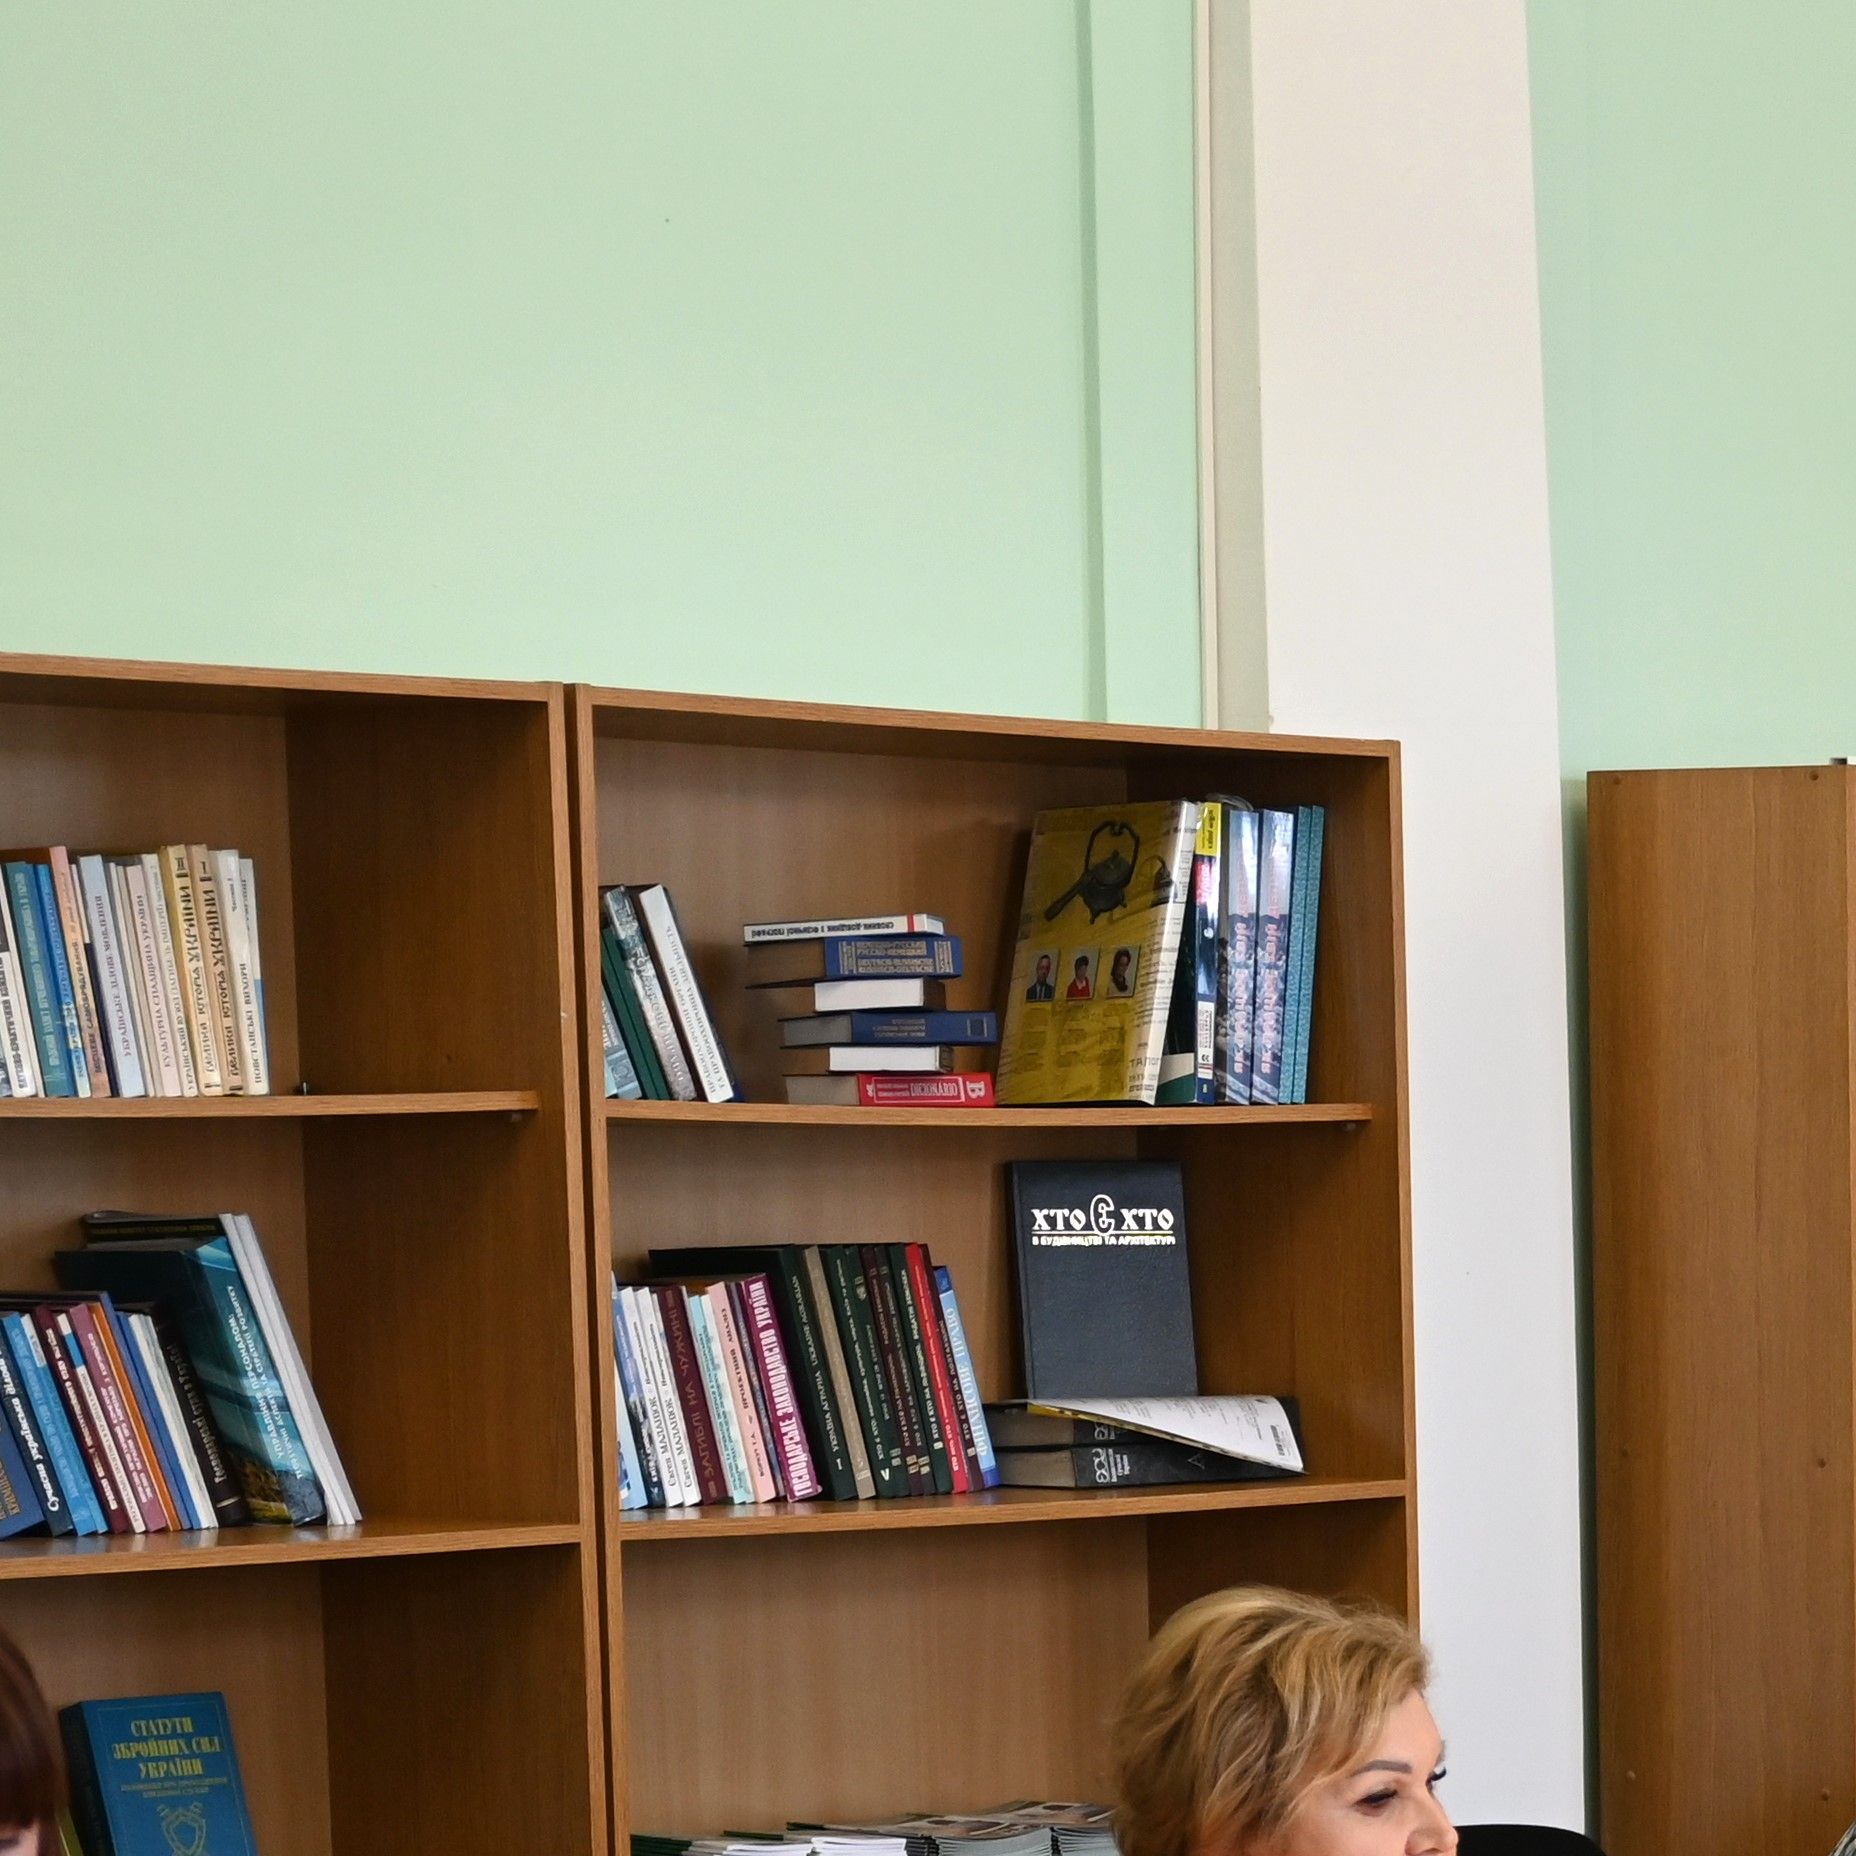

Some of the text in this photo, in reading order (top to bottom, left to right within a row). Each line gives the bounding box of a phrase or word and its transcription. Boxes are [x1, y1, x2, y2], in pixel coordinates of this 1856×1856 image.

[135, 894, 150, 940] УКРАЇНИ
[154, 1008, 171, 1068] КУЛЬТУРНА
[1031, 1194, 1174, 1236] ХТО Є ХТО
[1105, 1236, 1117, 1245] ТА
[747, 1279, 772, 1328] УКРАЇНИ
[667, 1308, 714, 1476] ЗАГИБЛІ НА ЧУЖИНІ
[758, 1327, 794, 1416] ЗАКОНОДАВСТВО
[944, 1306, 989, 1457] ФІНАНСОВЕ ПРАВО
[8, 1395, 42, 1461] українська
[778, 1416, 812, 1497] ГОСПОДАРСЬКЕ
[33, 1461, 61, 1512] Сучасна
[131, 1717, 194, 1738] СТАТУТИ
[139, 1758, 204, 1778] УКРАЇНИ
